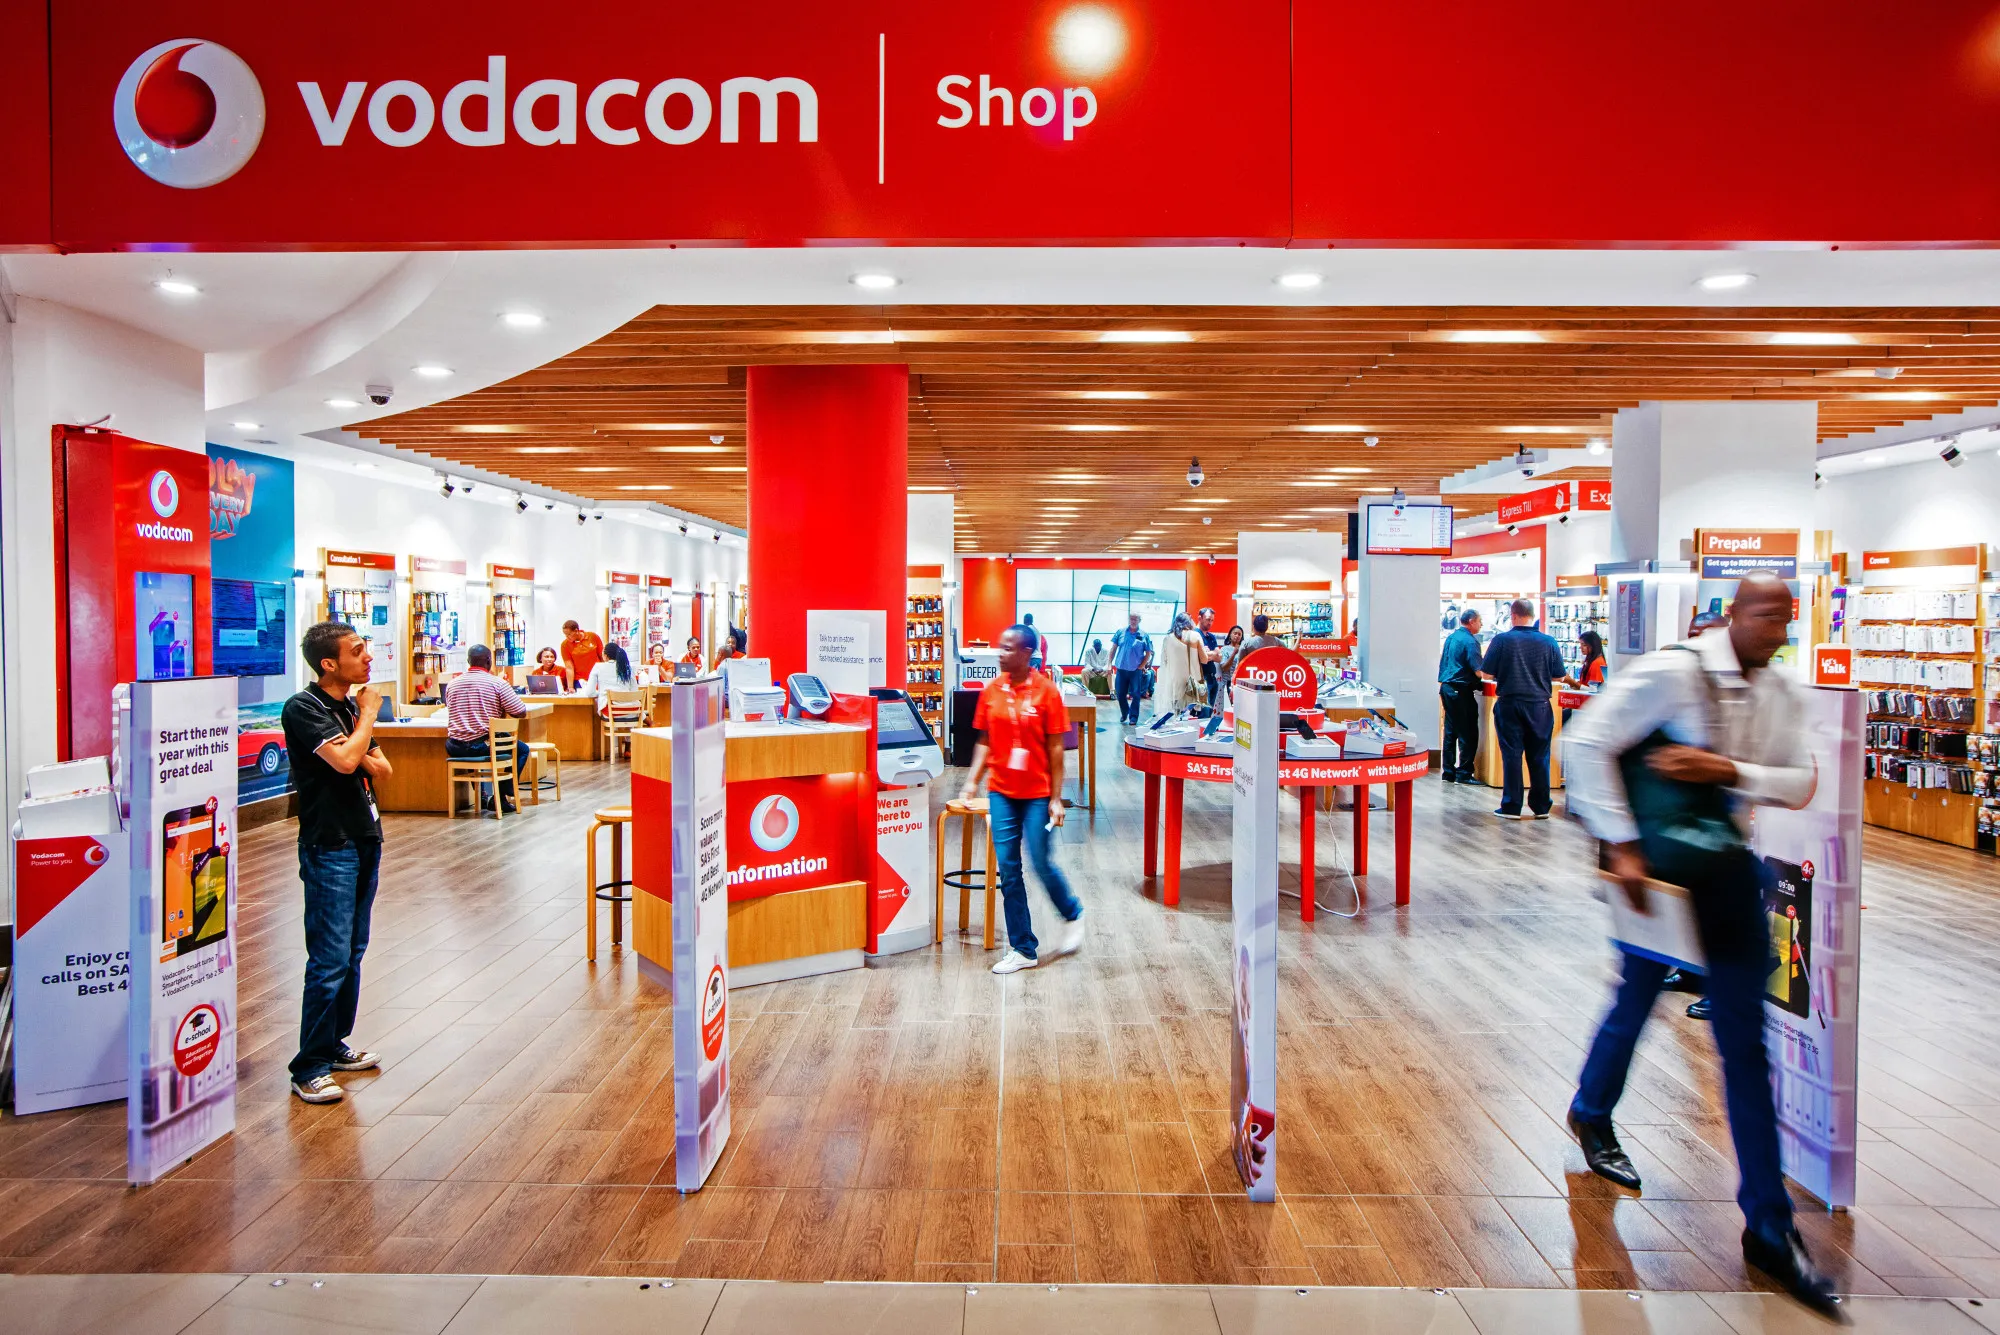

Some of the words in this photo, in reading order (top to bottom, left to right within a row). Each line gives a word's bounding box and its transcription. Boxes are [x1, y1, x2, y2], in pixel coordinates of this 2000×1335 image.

[297, 54, 819, 148] vodacom
[936, 74, 1098, 141] Shop
[210, 491, 245, 513] VERY
[1501, 503, 1522, 518] Express
[1523, 500, 1532, 513] Till
[136, 520, 193, 542] vodacom
[1709, 536, 1762, 552] Prepaid
[1441, 565, 1461, 573] ness
[1463, 565, 1486, 573] Zone
[1707, 559, 1720, 567] Get
[1720, 560, 1729, 568] up
[1730, 559, 1738, 567] to
[1757, 559, 1782, 567] Airtime
[819, 634, 828, 642] Talk
[828, 635, 833, 643] to
[1299, 643, 1341, 651] Accessories
[819, 645, 840, 653] consultant
[967, 666, 997, 679] DEEZER
[1246, 666, 1278, 683] Top
[1286, 670, 1302, 684] 10
[1823, 662, 1846, 674] Talk
[1278, 690, 1302, 698] ellers
[160, 729, 188, 744] Start
[190, 727, 207, 740] the
[209, 726, 229, 738] new
[159, 749, 184, 765] year
[186, 743, 209, 758] with
[211, 740, 229, 754] this
[160, 764, 189, 783] great
[191, 759, 213, 775] deal
[1187, 762, 1208, 774] SA's
[1292, 768, 1309, 779] 4G
[1368, 765, 1388, 777] with
[1389, 763, 1401, 774] the
[1403, 761, 1417, 773] least
[207, 798, 218, 809] 4G
[877, 799, 891, 809] We
[893, 798, 908, 808] are
[701, 815, 713, 831] Score
[713, 809, 722, 821] more
[877, 812, 899, 823] here
[901, 810, 911, 820] to
[878, 825, 904, 835] serve
[905, 821, 923, 834] you
[700, 833, 713, 849] value
[713, 829, 718, 842] on
[701, 851, 711, 867] SA's
[711, 844, 720, 861] First
[701, 868, 710, 886] and
[710, 862, 719, 879] Best
[726, 855, 828, 886] nformation
[1803, 863, 1814, 875] 4G
[1778, 880, 1795, 892] 09:00
[701, 888, 708, 902] 4G
[65, 953, 112, 967] Enjoy
[162, 968, 185, 981] Vodacom
[186, 962, 201, 972] Smart
[202, 956, 214, 966] turbo
[41, 970, 82, 985] calls
[85, 968, 106, 980] on
[162, 974, 193, 991] Smartphone
[78, 981, 115, 996] Best
[117, 979, 129, 990] 4
[166, 983, 189, 996] Vodacom
[190, 976, 205, 987] Smart
[185, 1025, 211, 1043] e-school
[1783, 1031, 1798, 1044] Smart
[1798, 1038, 1806, 1049] Tab
[1784, 1022, 1813, 1043] Smartphone
